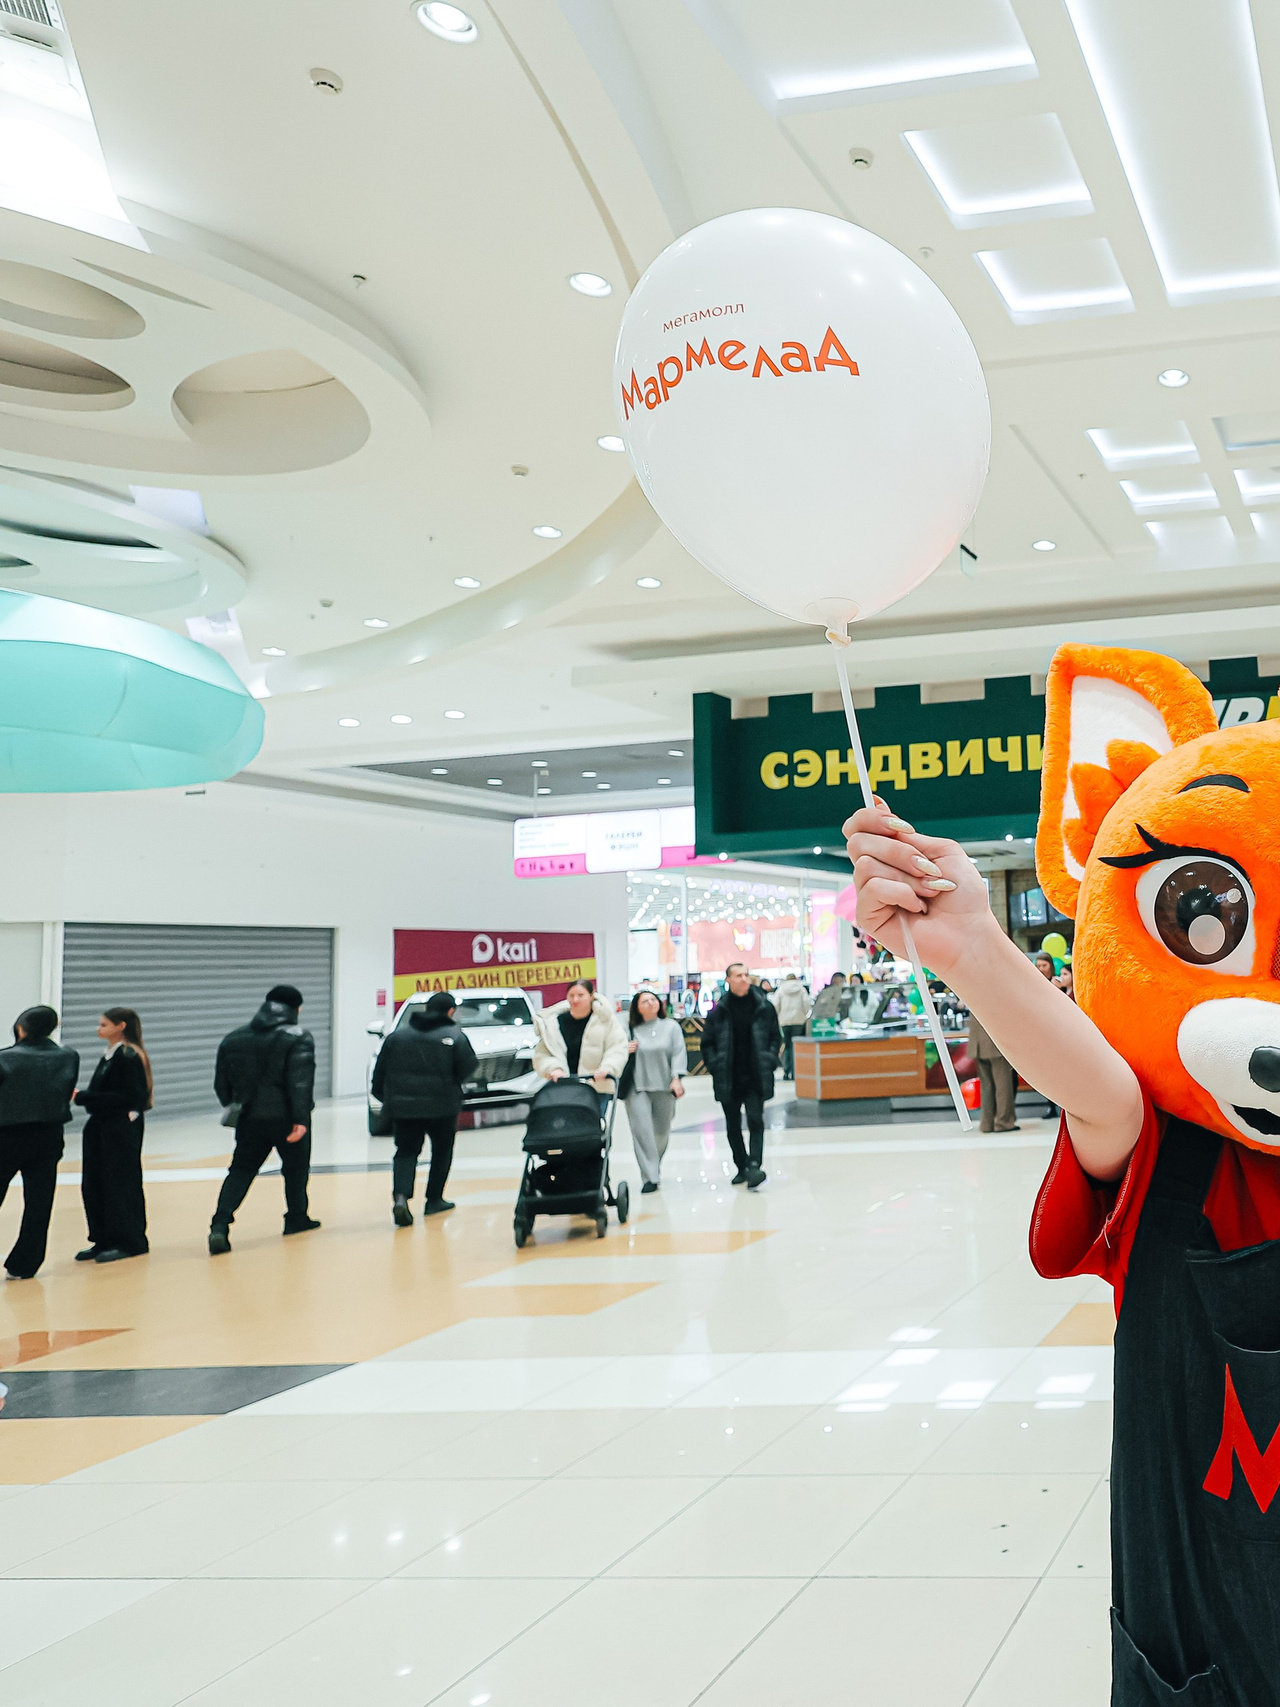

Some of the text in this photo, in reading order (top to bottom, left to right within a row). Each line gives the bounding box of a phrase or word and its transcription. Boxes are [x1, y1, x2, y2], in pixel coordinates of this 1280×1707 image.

[662, 303, 745, 333] мегамолл
[497, 937, 538, 963] kari
[415, 963, 582, 993] МАГАЗИН ПЕРЕЕХАЛ
